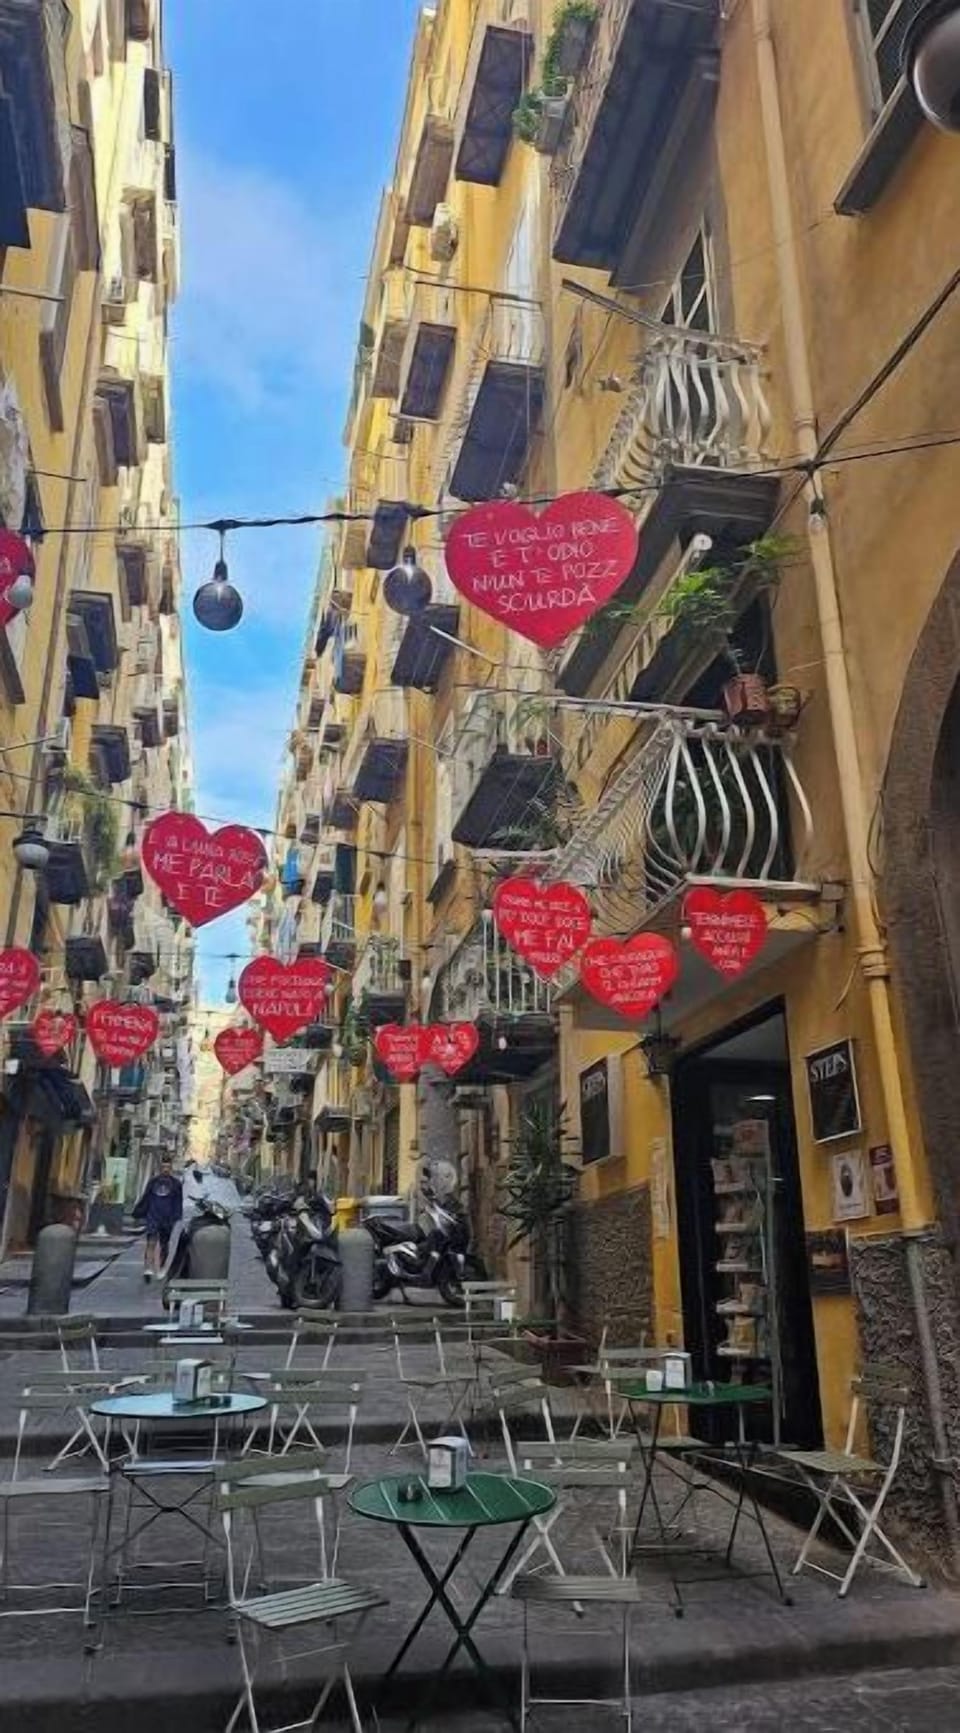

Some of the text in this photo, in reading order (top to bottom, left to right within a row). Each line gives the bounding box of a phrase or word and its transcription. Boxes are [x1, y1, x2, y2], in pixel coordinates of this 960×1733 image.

[461, 531, 487, 548] TE
[494, 524, 566, 546] VOGLIO
[488, 550, 508, 569] E
[530, 568, 553, 585] TE
[153, 850, 185, 875] ME
